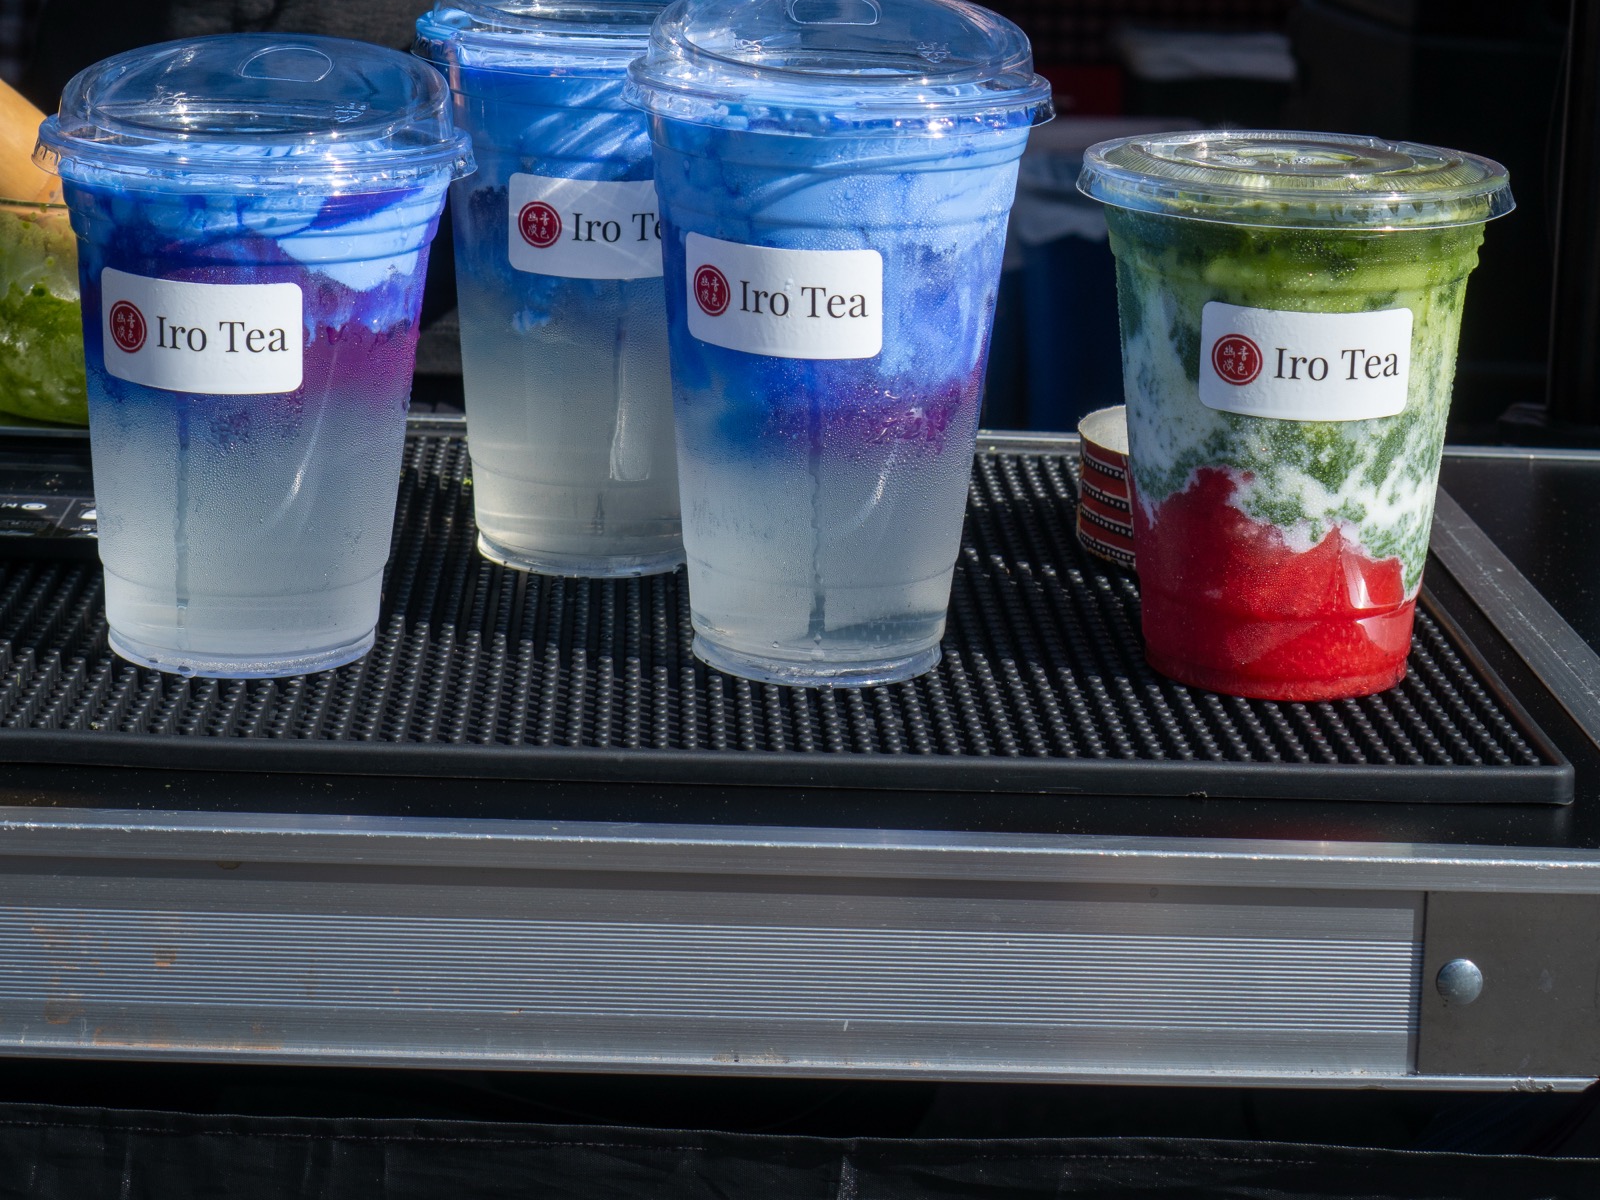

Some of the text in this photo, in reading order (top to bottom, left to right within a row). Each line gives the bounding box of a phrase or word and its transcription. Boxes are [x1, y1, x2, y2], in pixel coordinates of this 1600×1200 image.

[572, 213, 621, 242] Iro
[740, 280, 869, 318] Iro Tea
[156, 316, 289, 352] Iro Tea
[1274, 348, 1399, 381] Iro Tea
